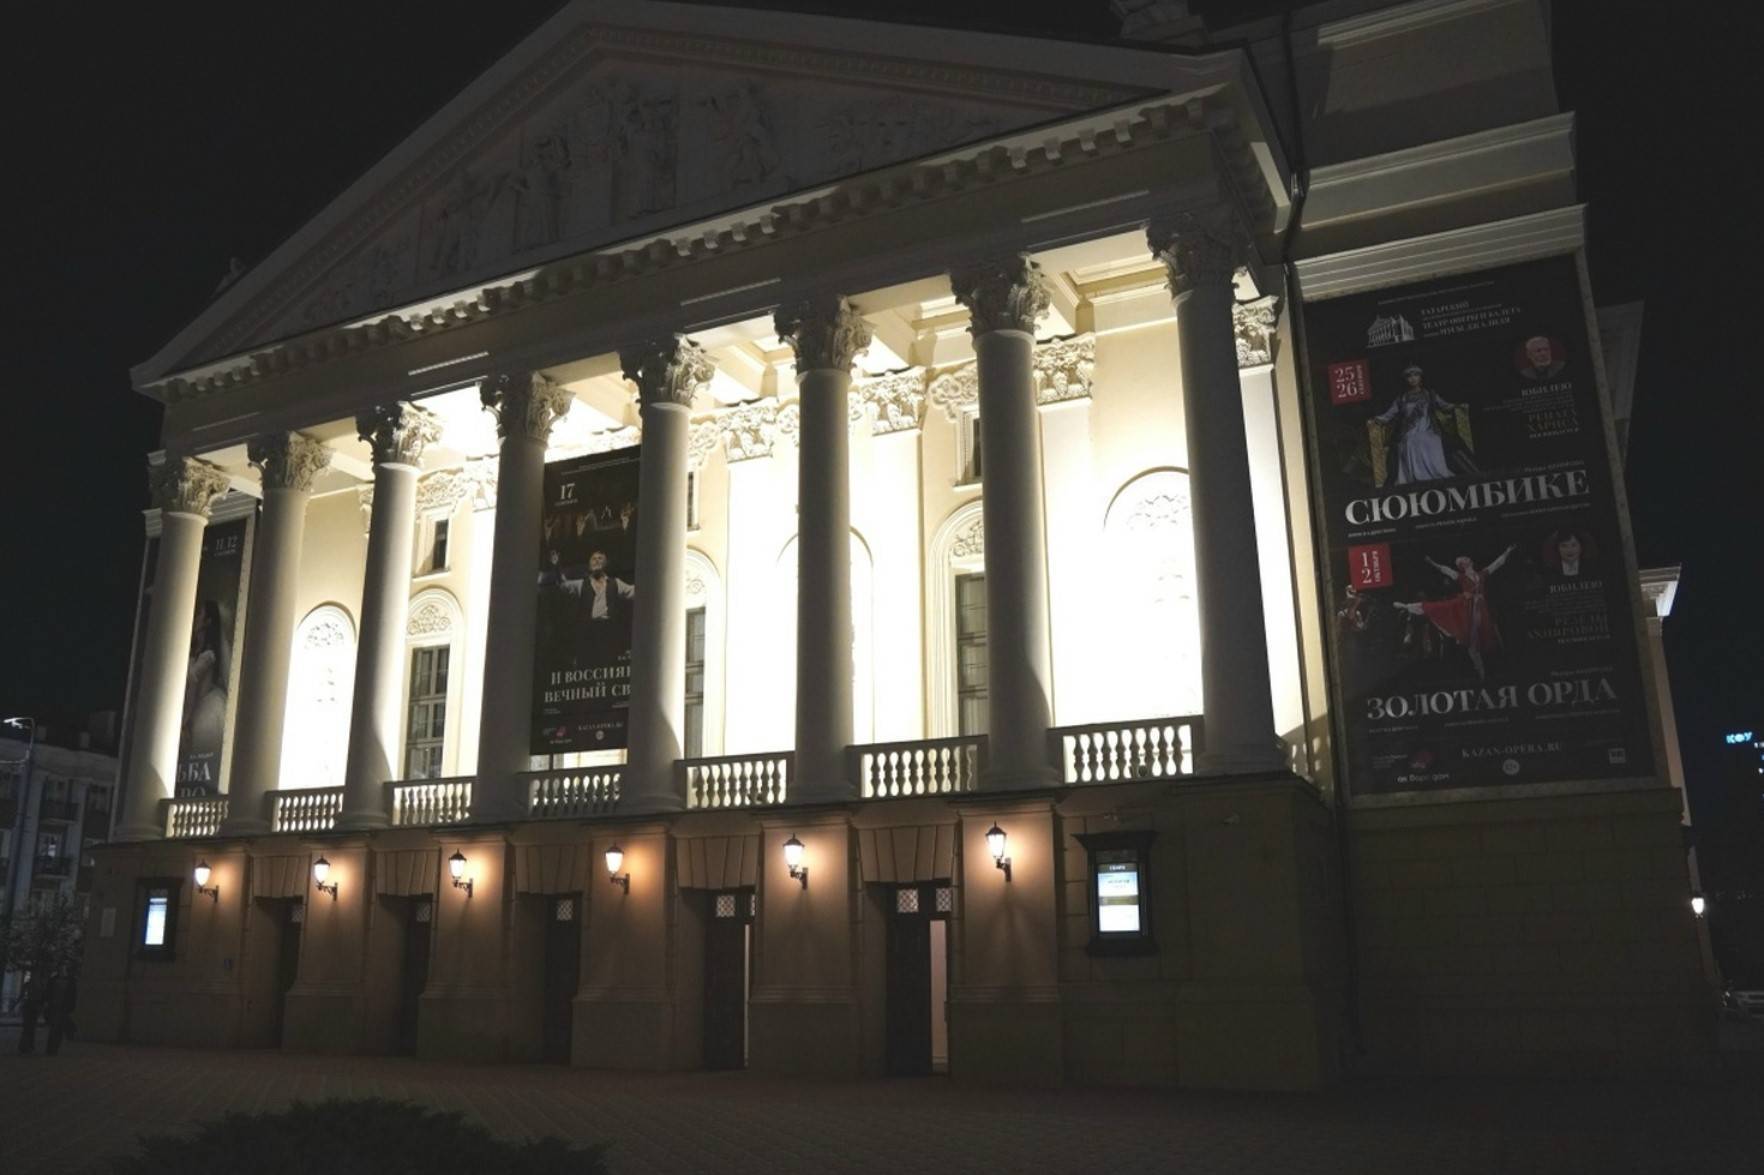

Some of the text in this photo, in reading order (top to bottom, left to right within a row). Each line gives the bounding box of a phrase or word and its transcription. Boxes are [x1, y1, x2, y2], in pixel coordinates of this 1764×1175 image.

[1334, 365, 1355, 383] 25
[1336, 381, 1358, 398] 26
[560, 482, 576, 500] 17
[1345, 470, 1590, 525] СЮЮМБИКЕ
[1361, 551, 1369, 567] 1
[1361, 567, 1372, 584] 2
[544, 681, 631, 703] ВЕЧНЫЙ СВ
[1367, 677, 1618, 719] ЗОЛОТАЯ ОРДА
